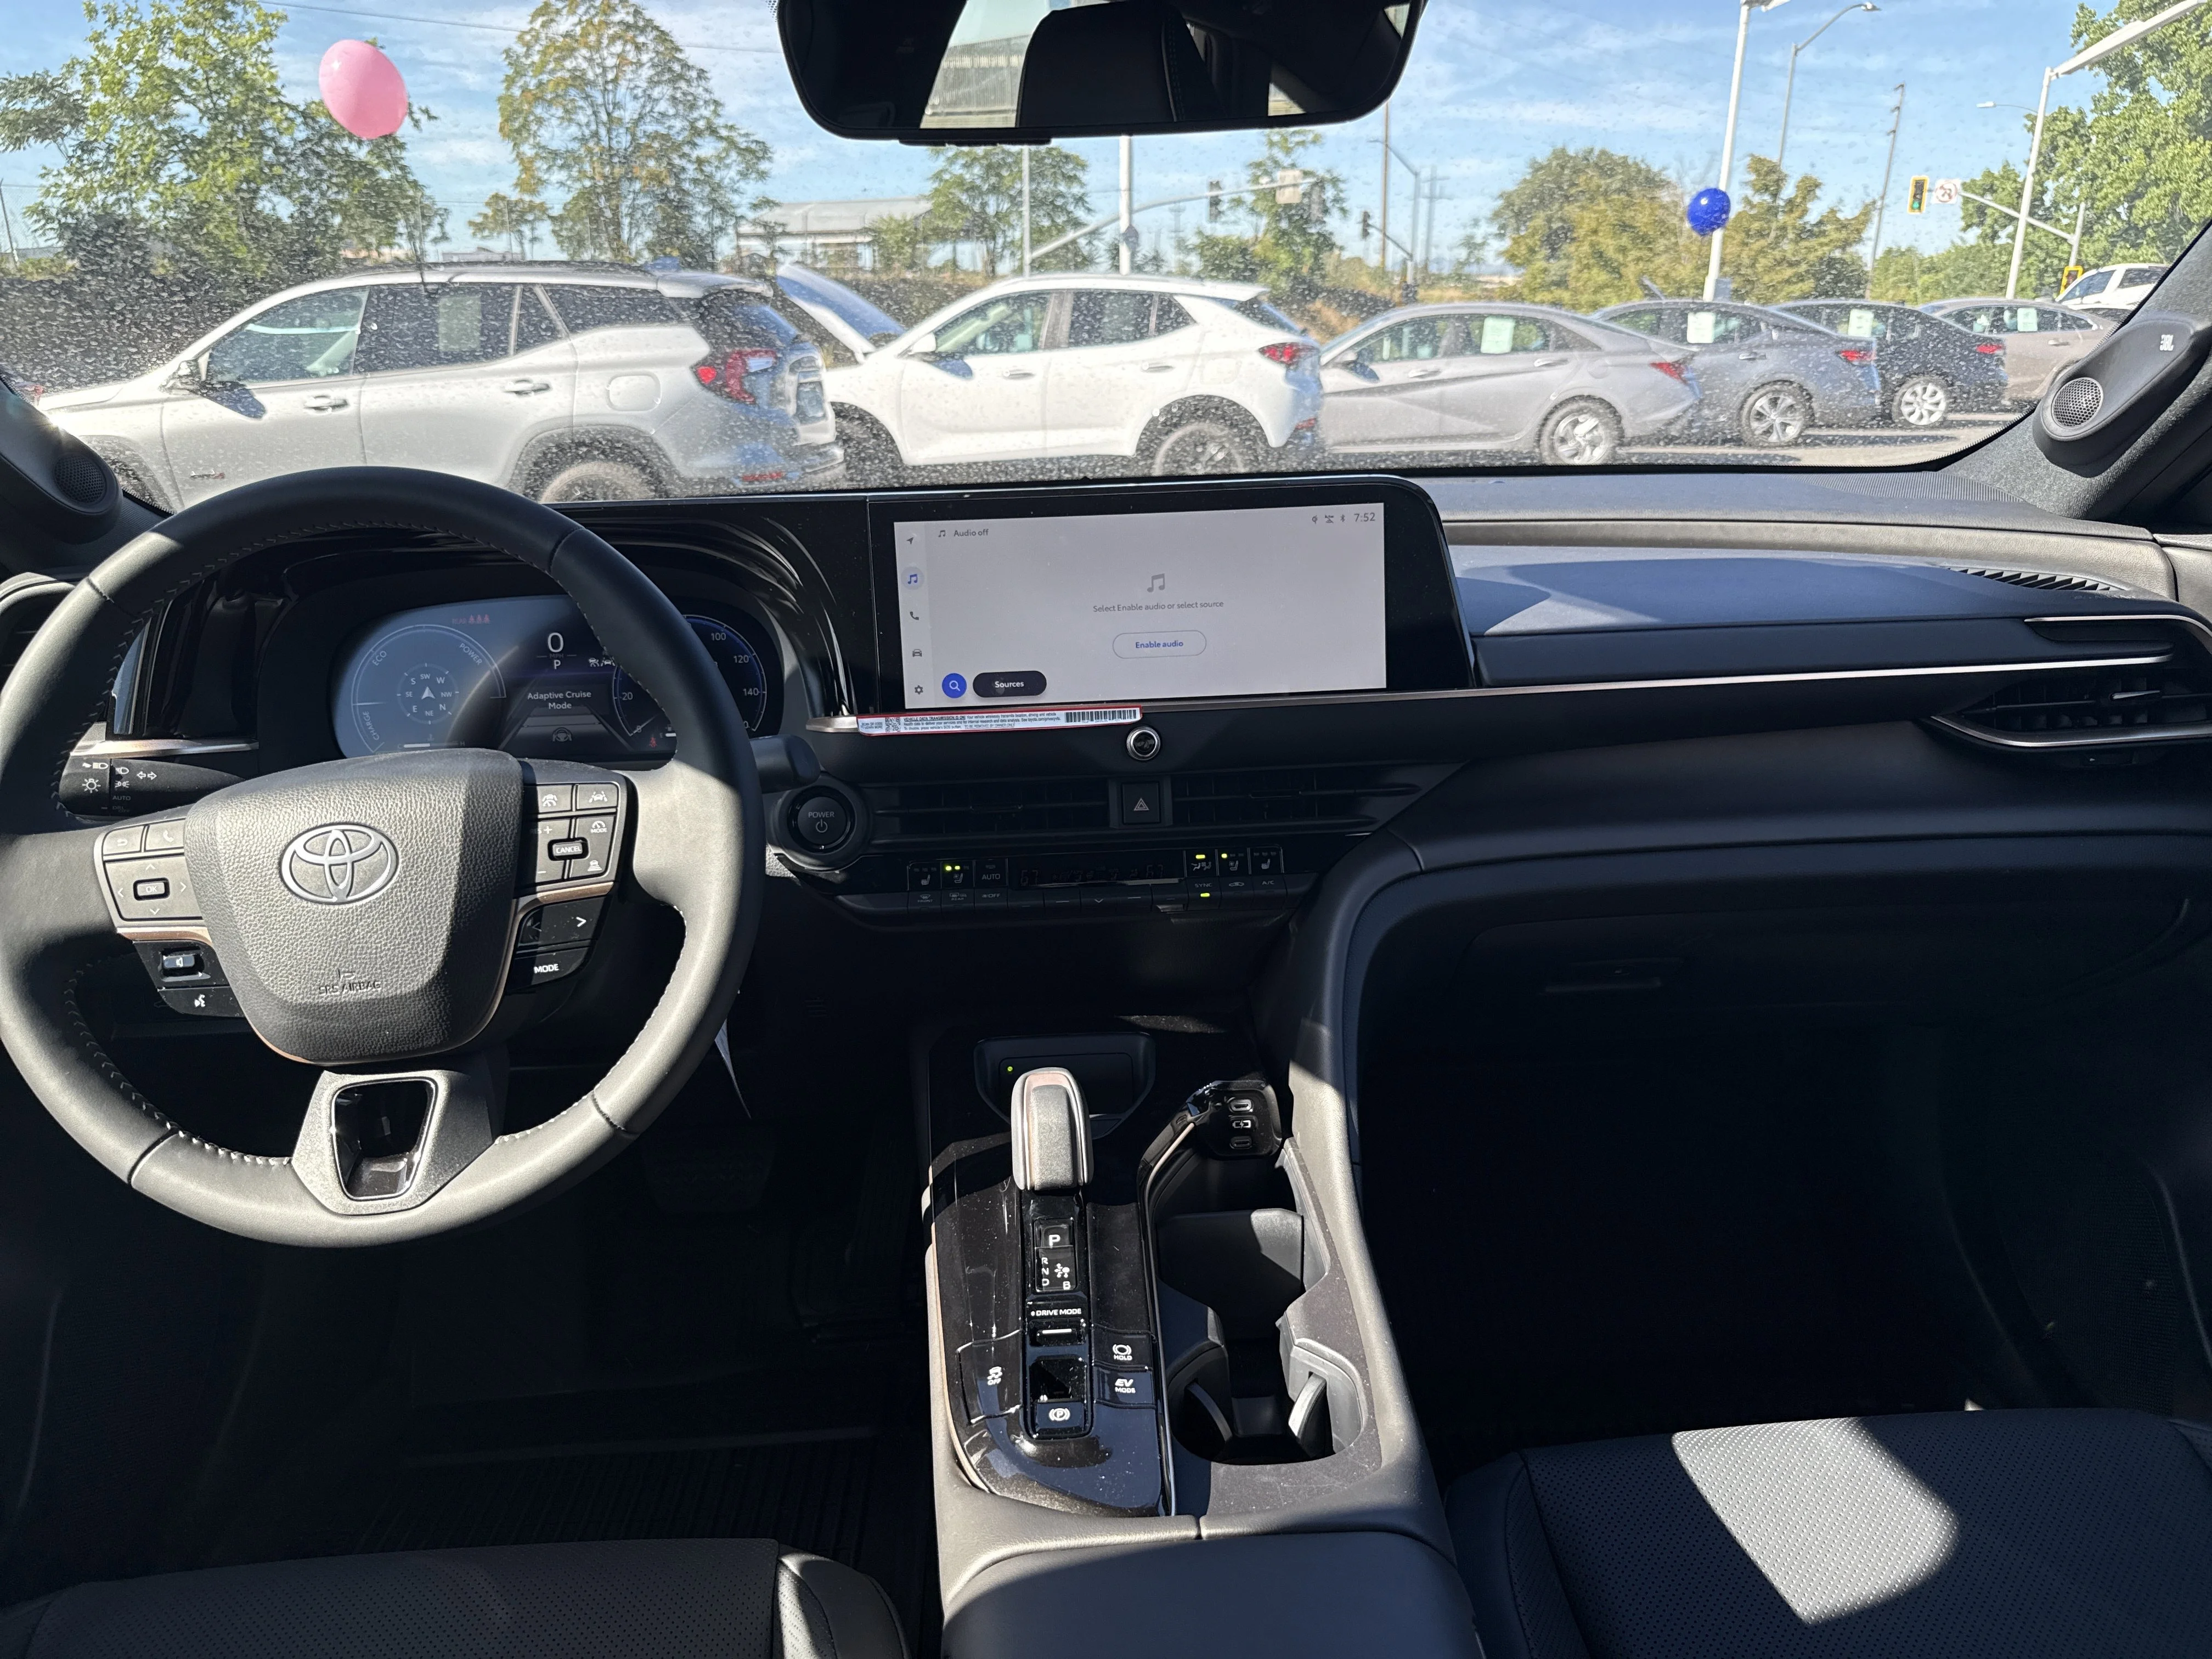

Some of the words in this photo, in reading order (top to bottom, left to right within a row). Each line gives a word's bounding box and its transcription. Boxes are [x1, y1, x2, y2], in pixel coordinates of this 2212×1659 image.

[1354, 512, 1376, 522] 7:52
[710, 633, 727, 641] 100
[547, 632, 565, 653] 0
[371, 650, 387, 667] ECO
[459, 642, 483, 666] POWER
[733, 654, 749, 664] 120
[554, 659, 561, 670] P
[527, 692, 564, 701] Adaptive
[622, 692, 634, 701] 20
[743, 687, 759, 696] 140
[549, 701, 572, 709] Mode
[362, 710, 380, 741] CHARGE
[556, 845, 582, 854] CANCEL
[533, 963, 559, 974] MODE
[342, 980, 382, 994] AIRBAG
[1048, 1234, 1060, 1247] P
[1042, 1278, 1049, 1286] D
[1063, 1280, 1071, 1290] B
[1115, 1378, 1134, 1387] EV
